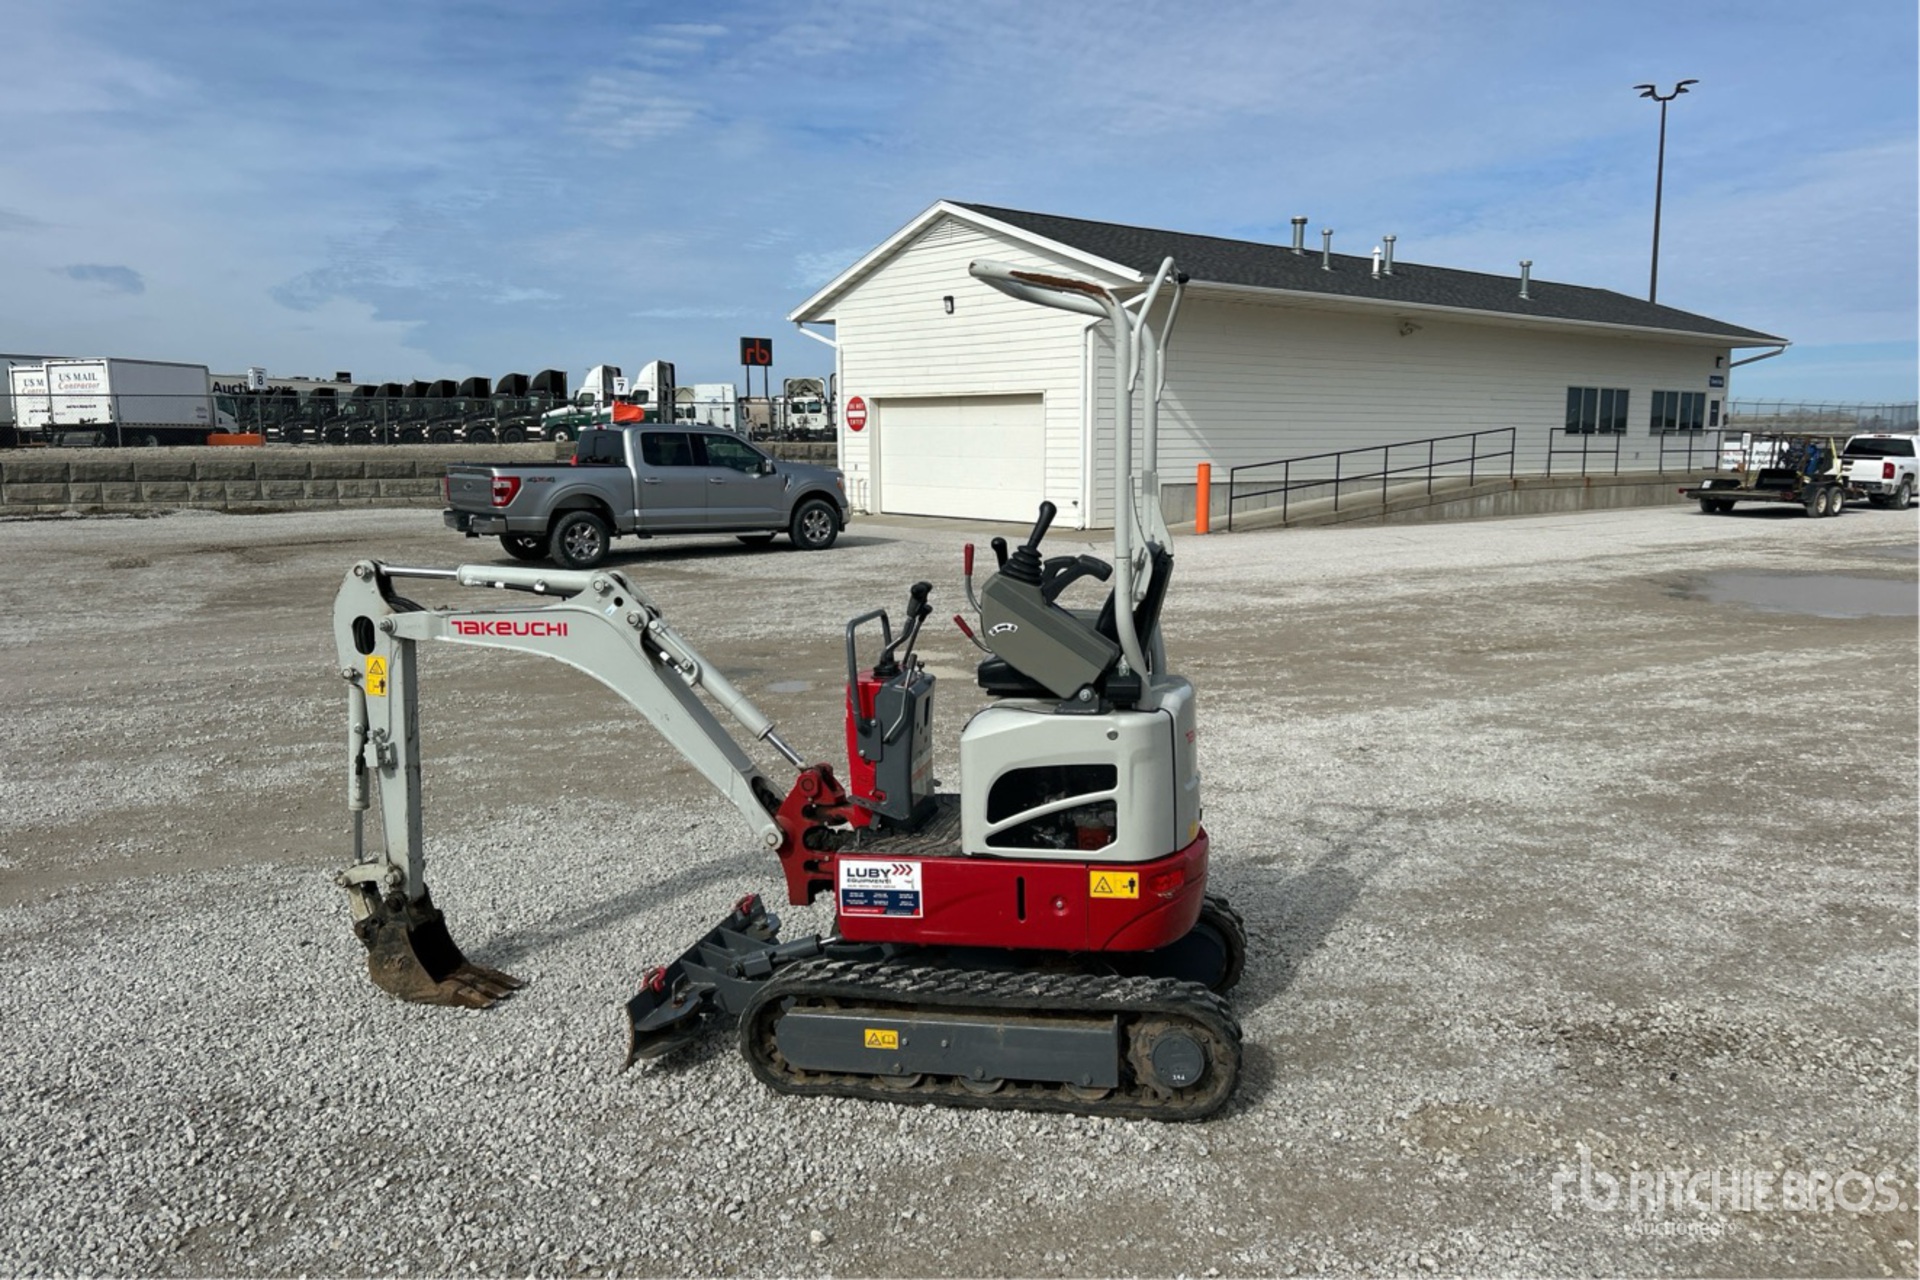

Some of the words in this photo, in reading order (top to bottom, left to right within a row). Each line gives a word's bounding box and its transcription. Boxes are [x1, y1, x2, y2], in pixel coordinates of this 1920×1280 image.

[745, 340, 769, 364] rb
[59, 373, 71, 381] US
[73, 372, 97, 381] MAIL
[257, 376, 264, 386] 8
[57, 381, 100, 390] Contractor
[618, 383, 625, 392] 7
[21, 387, 46, 395] Contra
[847, 867, 891, 878] LUBY
